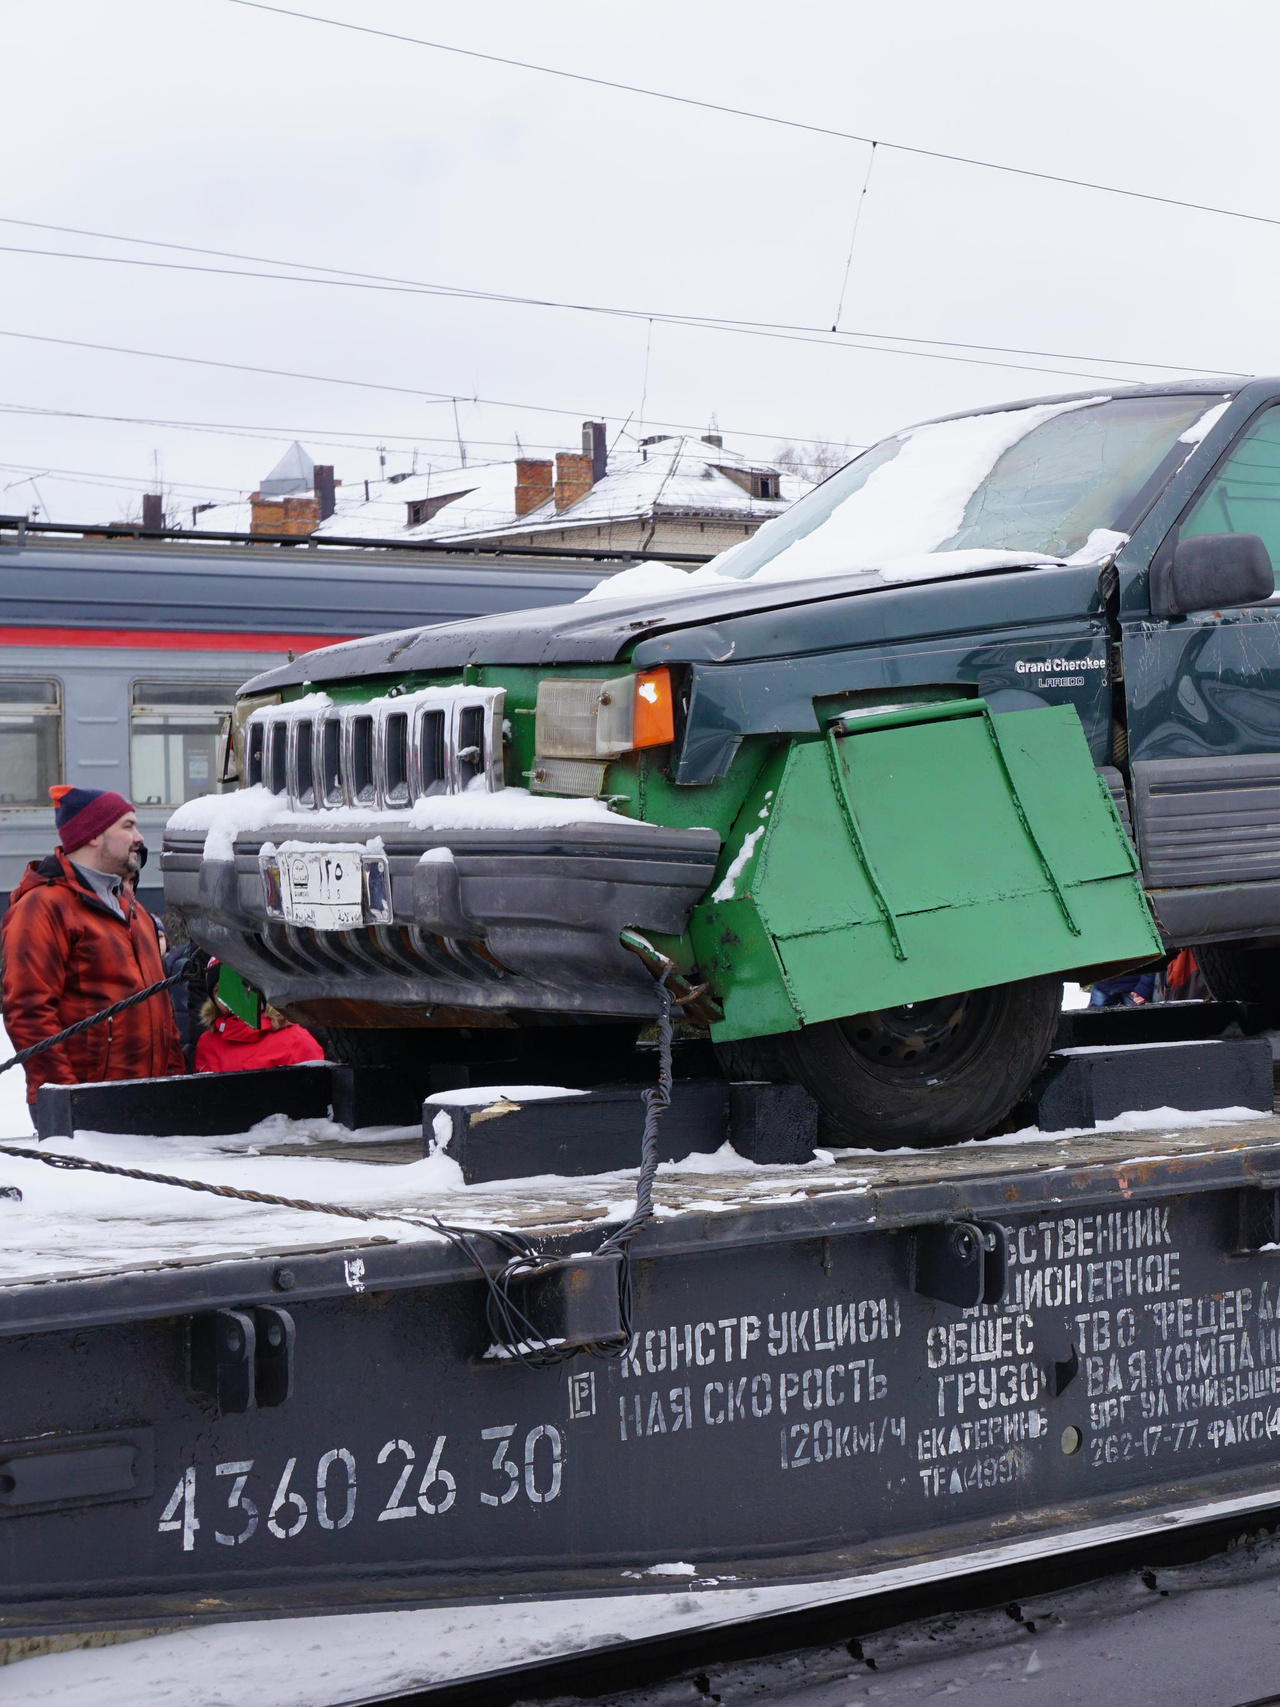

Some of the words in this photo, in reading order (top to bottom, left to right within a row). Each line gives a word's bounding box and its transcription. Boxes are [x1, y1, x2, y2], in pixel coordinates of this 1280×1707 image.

[1015, 659, 1051, 673] Grand
[1052, 656, 1106, 672] Cherokee
[1038, 676, 1084, 687] LAREDO
[620, 1298, 902, 1378] КОНСТРУКЦИОН
[927, 1313, 1034, 1369] ОБЩЕС
[619, 1386, 693, 1441] НАЯ
[704, 1358, 888, 1426] СКОРОСТЬ
